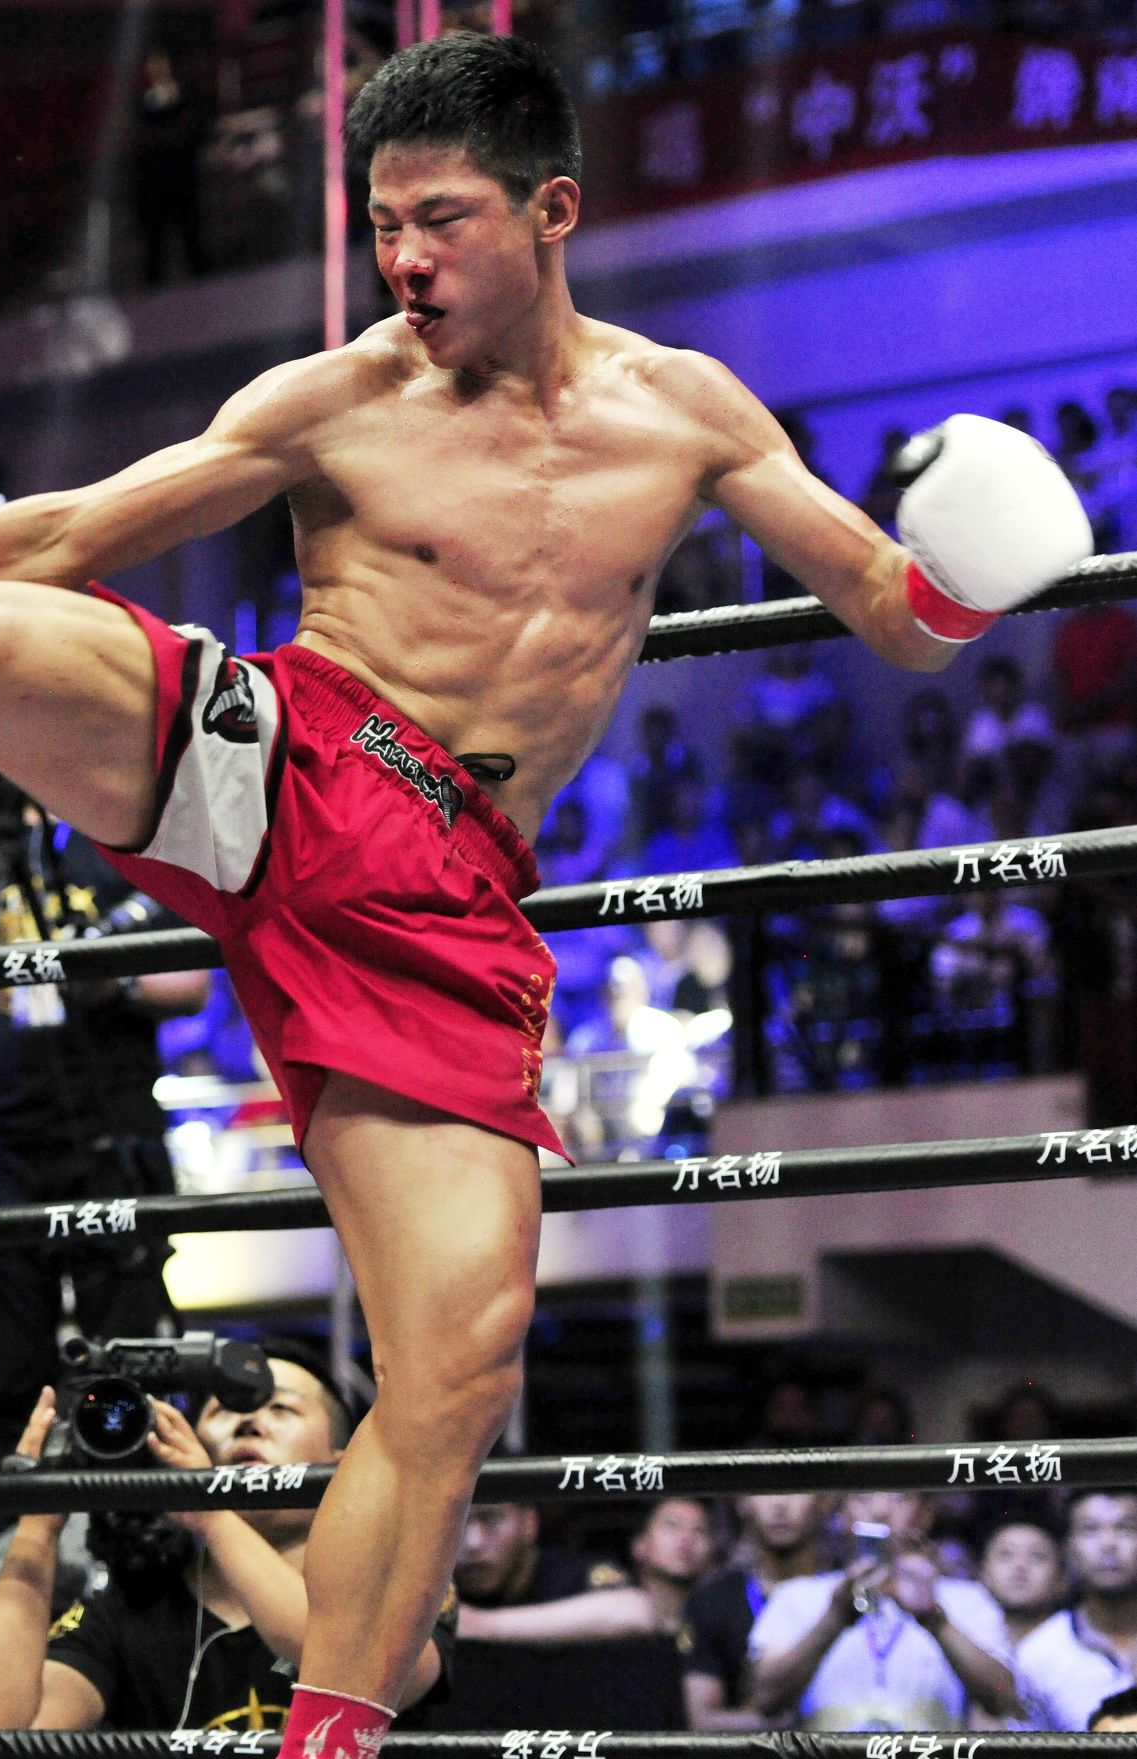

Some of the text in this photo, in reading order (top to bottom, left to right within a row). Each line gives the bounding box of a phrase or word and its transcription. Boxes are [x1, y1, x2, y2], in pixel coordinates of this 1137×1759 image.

[951, 842, 1067, 885] 万名扬
[598, 873, 704, 916] 万名扬
[672, 1150, 782, 1192] 万名扬
[44, 1198, 137, 1238] 万名扬
[206, 1463, 311, 1494] 万名扬
[558, 1454, 665, 1493] 万名扬
[945, 1444, 1062, 1484] 万名扬
